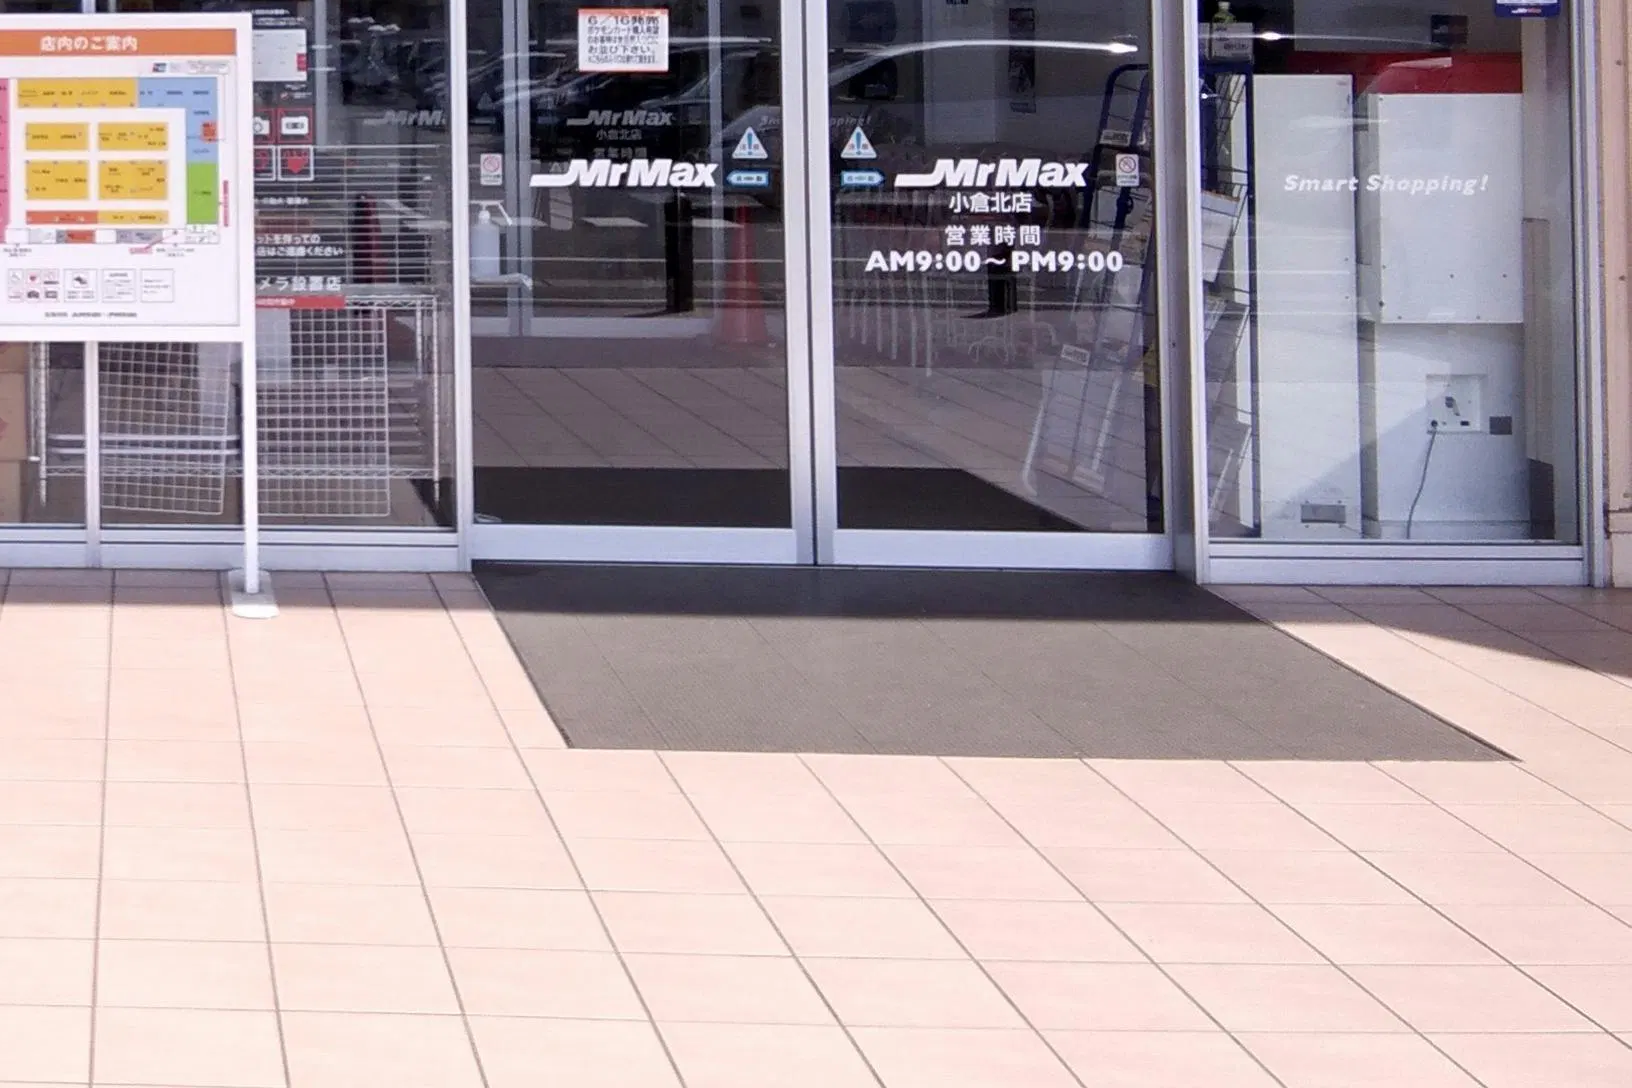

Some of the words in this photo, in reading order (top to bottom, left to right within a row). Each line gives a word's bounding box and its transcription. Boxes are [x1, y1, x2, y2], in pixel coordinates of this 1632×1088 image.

[40, 34, 139, 53] 店内のご案内
[529, 159, 719, 187] MrMax
[894, 159, 1090, 187] MrMax
[1283, 174, 1360, 192] Smart
[1365, 174, 1490, 196] Shopping!
[948, 192, 1033, 214] 小倉北店
[944, 225, 1042, 247] 営業時間
[259, 275, 342, 292] メラ設置店
